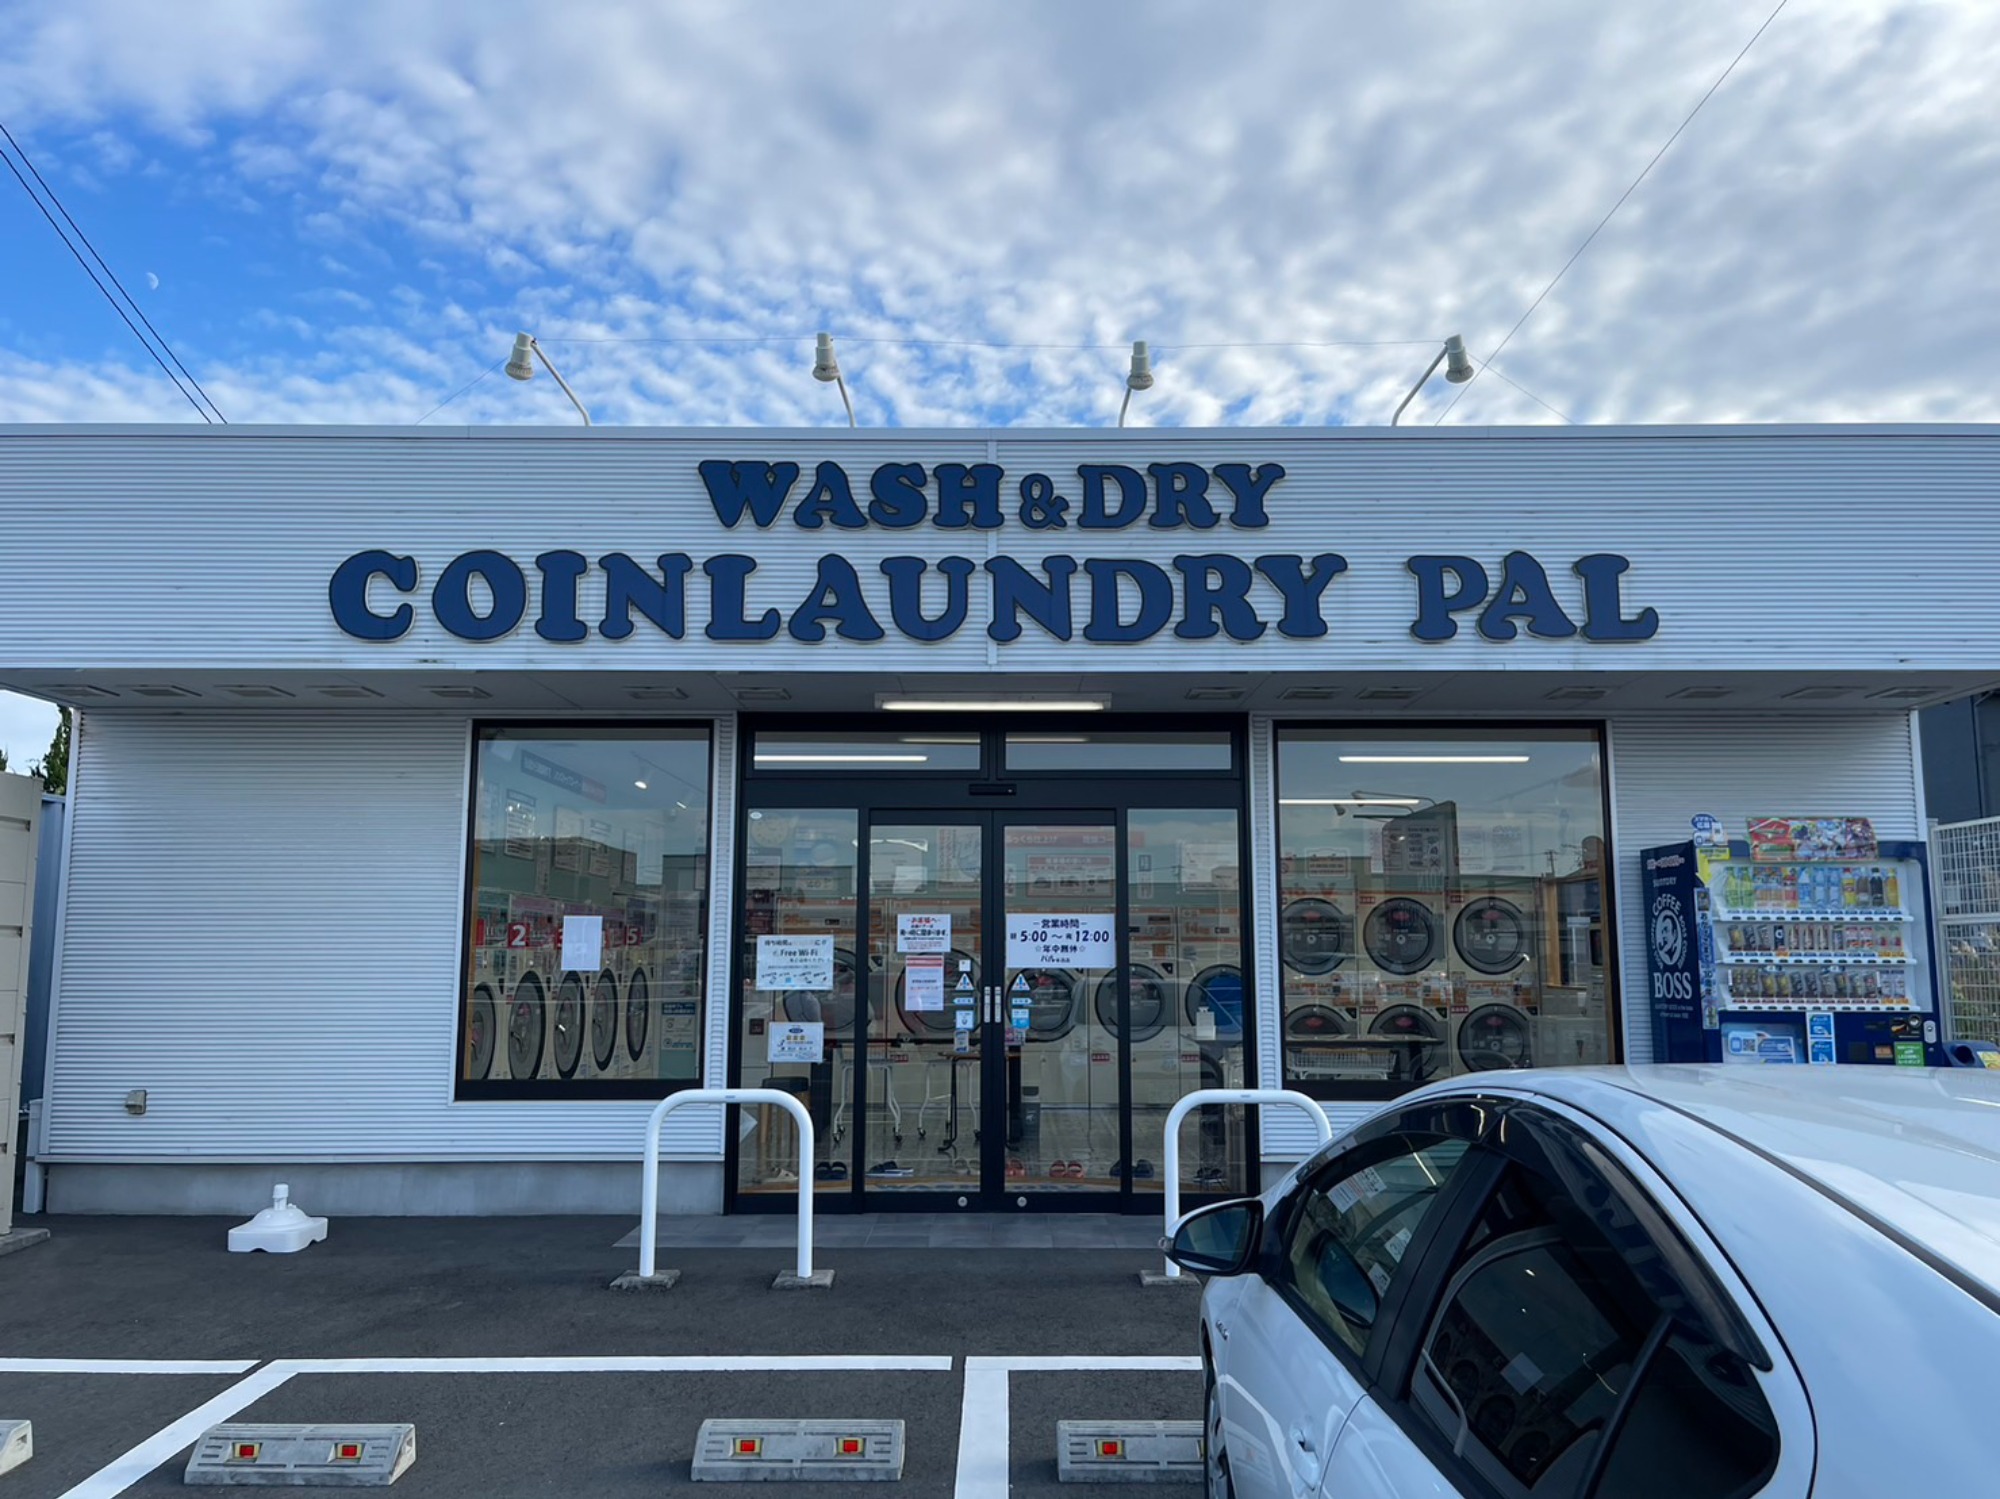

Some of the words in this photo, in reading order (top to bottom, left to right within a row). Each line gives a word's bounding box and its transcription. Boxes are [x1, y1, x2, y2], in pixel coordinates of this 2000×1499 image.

[329, 549, 1347, 643] COINLAUNDRY
[1406, 549, 1659, 643] PAL
[1652, 893, 1682, 917] COFFEE
[1041, 918, 1080, 929] 営業時間
[511, 925, 526, 946] 2
[626, 928, 638, 944] 5
[1020, 930, 1048, 942] 5:00
[1075, 930, 1110, 942] 12:00
[780, 949, 797, 957] Free
[1653, 971, 1693, 999] BOSS
